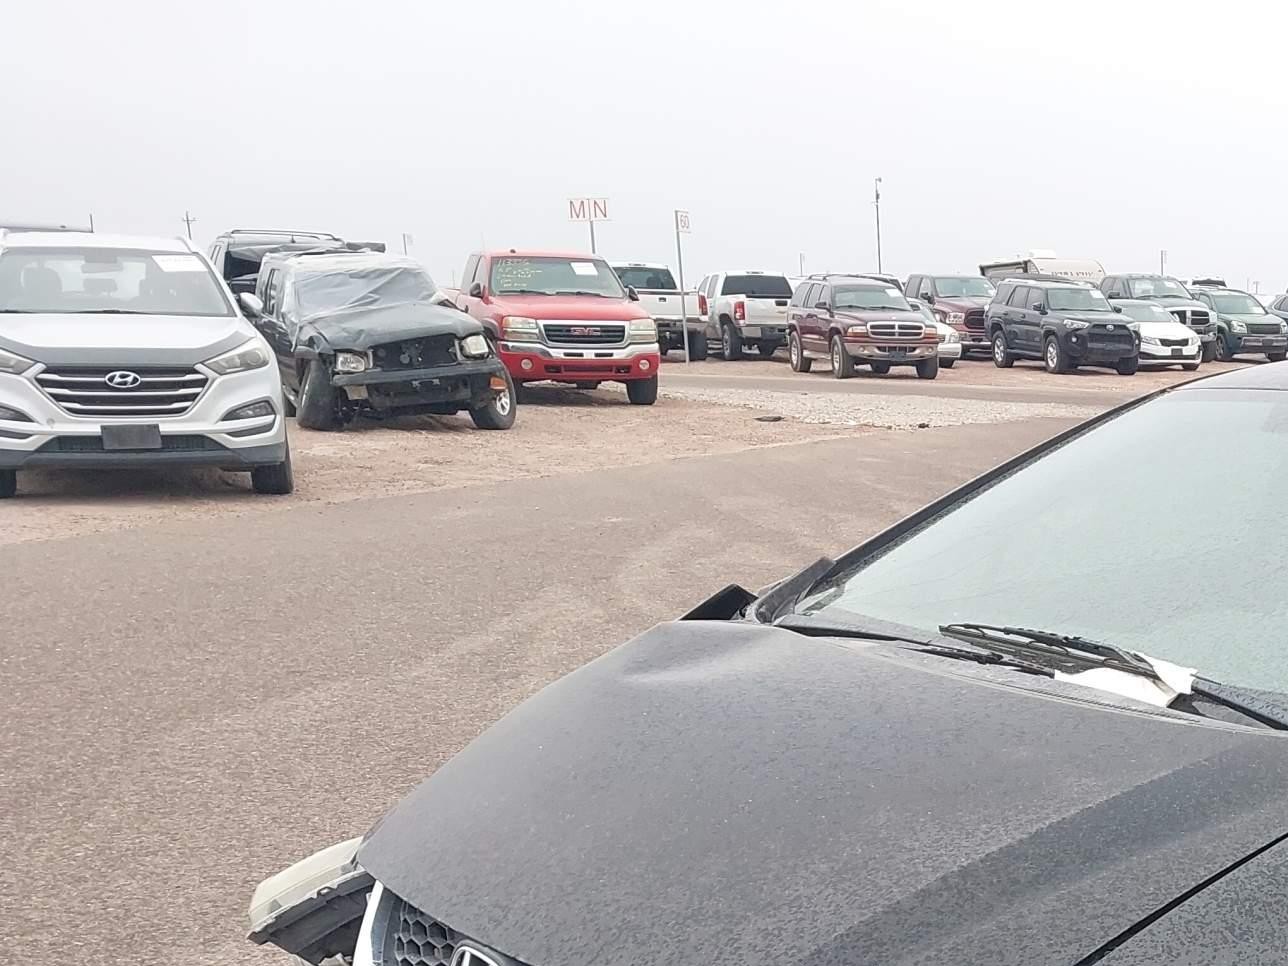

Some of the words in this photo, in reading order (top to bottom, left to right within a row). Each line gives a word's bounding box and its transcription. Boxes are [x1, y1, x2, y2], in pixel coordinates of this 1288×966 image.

[569, 199, 586, 219] M
[593, 199, 608, 218] N
[570, 327, 601, 336] GMC
